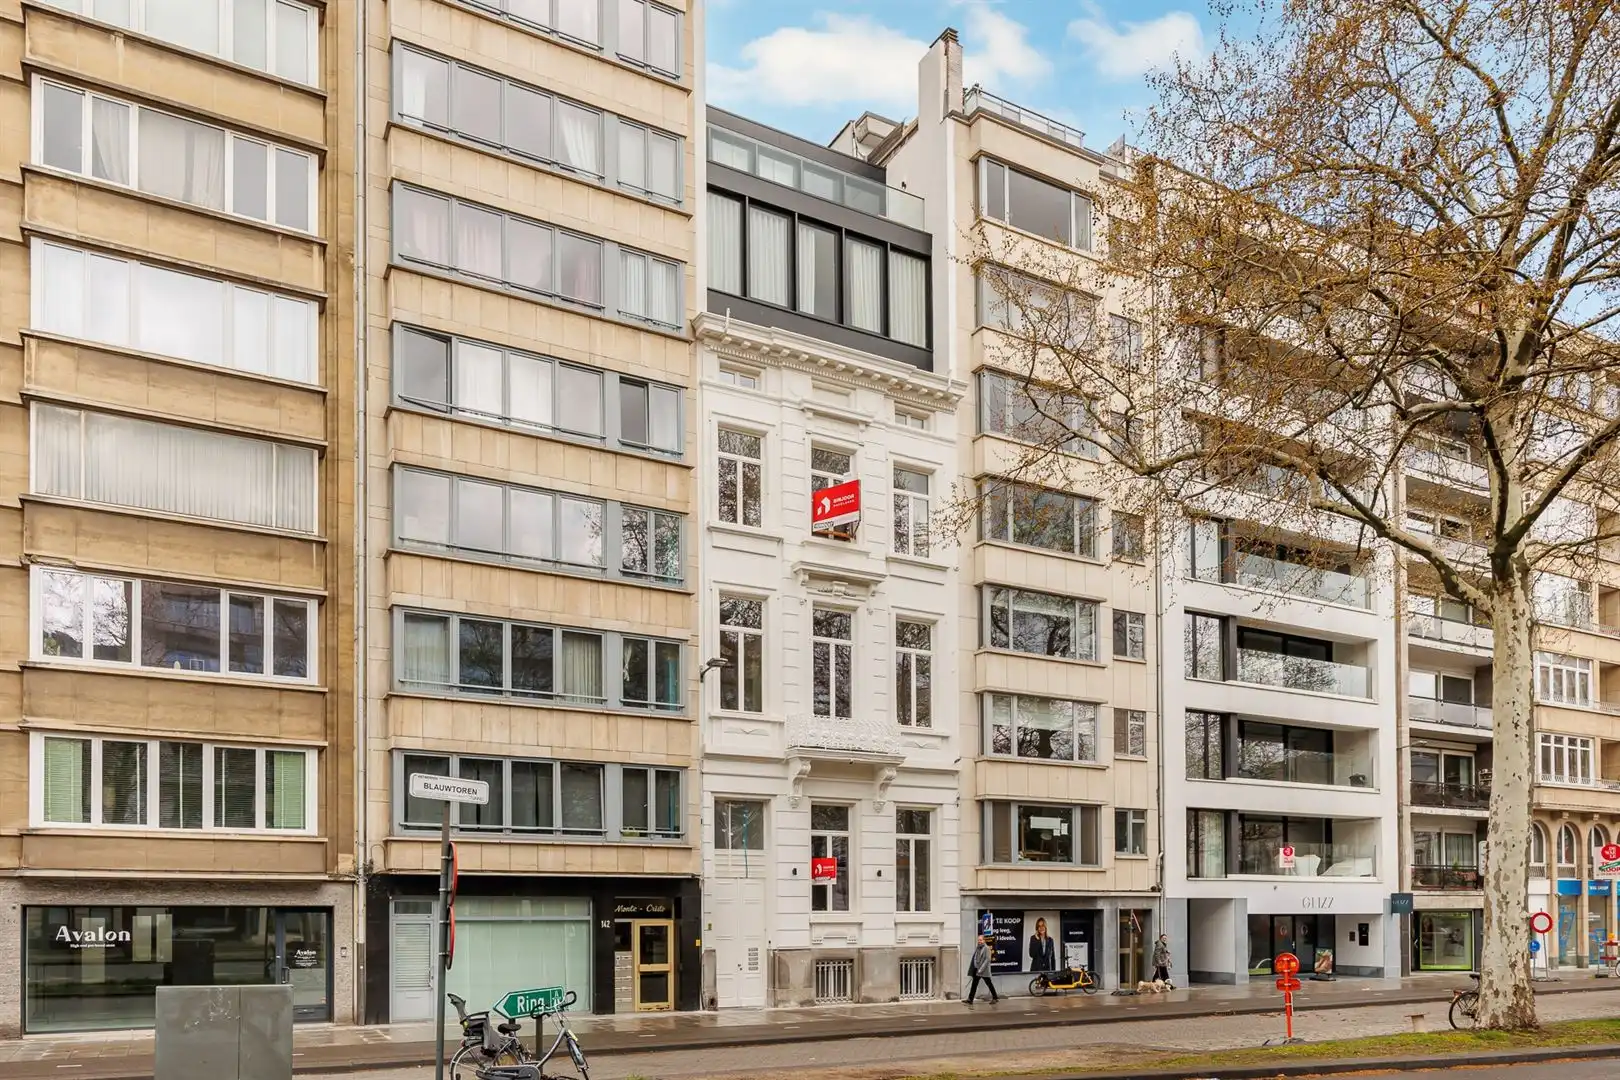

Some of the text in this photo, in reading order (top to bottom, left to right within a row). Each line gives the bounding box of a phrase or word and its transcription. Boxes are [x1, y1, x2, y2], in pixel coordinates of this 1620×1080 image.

[423, 782, 478, 795] BLAUWTOREN
[600, 920, 611, 928] 142
[55, 925, 131, 942] Avalon
[517, 995, 545, 1014] Ring
